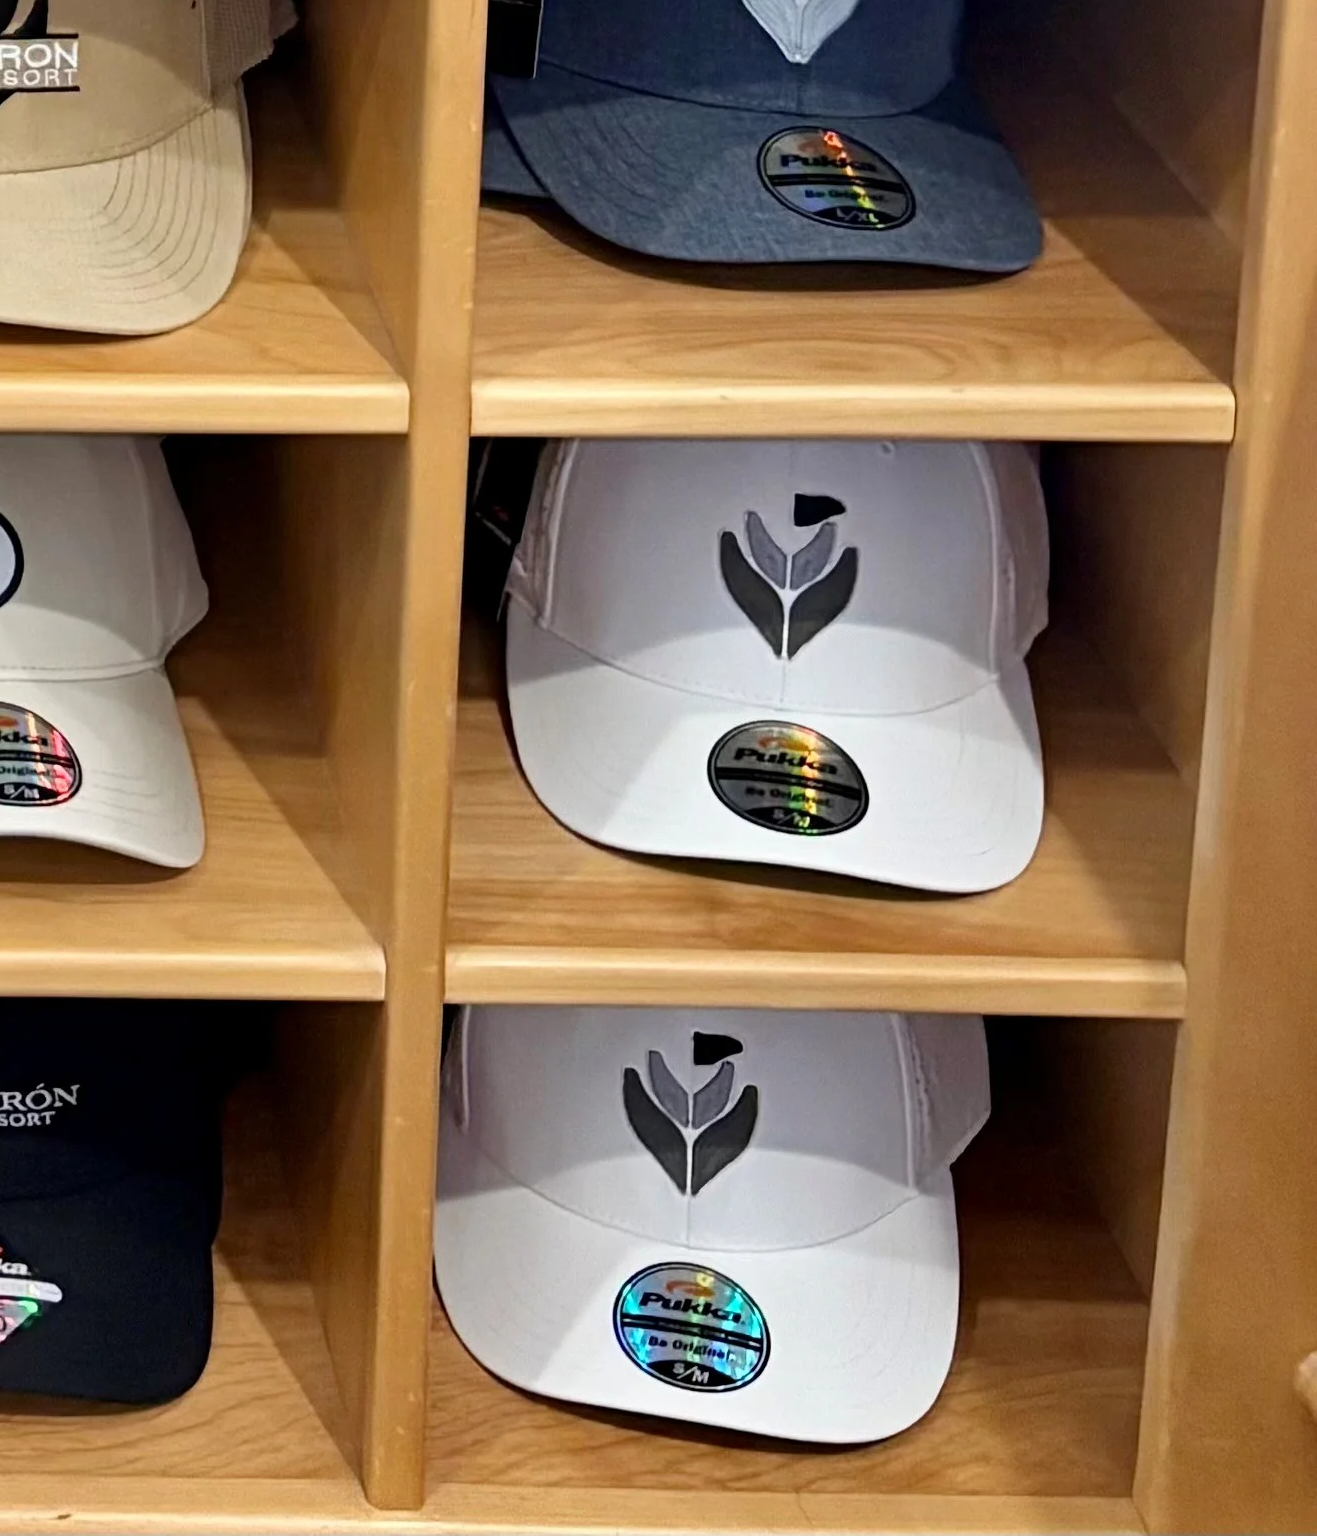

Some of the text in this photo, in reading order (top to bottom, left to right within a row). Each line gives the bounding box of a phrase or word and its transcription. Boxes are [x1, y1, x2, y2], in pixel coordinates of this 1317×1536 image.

[733, 747, 838, 775] Pukka
[638, 1292, 743, 1324] Pukka
[672, 1361, 710, 1384] S/M
